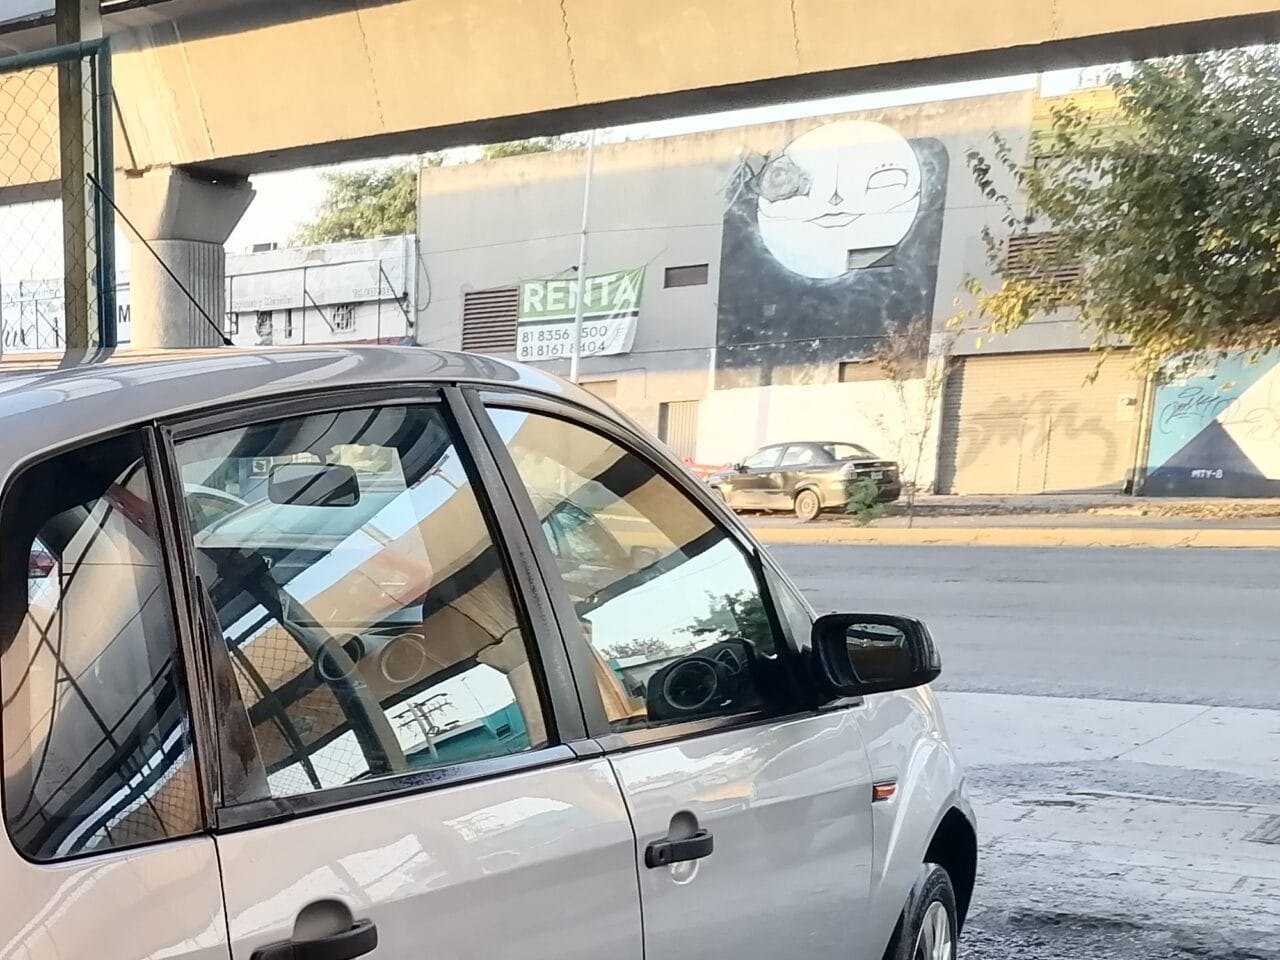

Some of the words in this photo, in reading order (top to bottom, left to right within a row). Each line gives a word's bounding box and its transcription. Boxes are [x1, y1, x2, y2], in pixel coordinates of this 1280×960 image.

[523, 274, 638, 313] RENTA
[522, 331, 534, 343] 81
[537, 329, 569, 342] 8356
[570, 325, 608, 340] 500
[521, 346, 534, 357] 81
[537, 344, 565, 356] 8161
